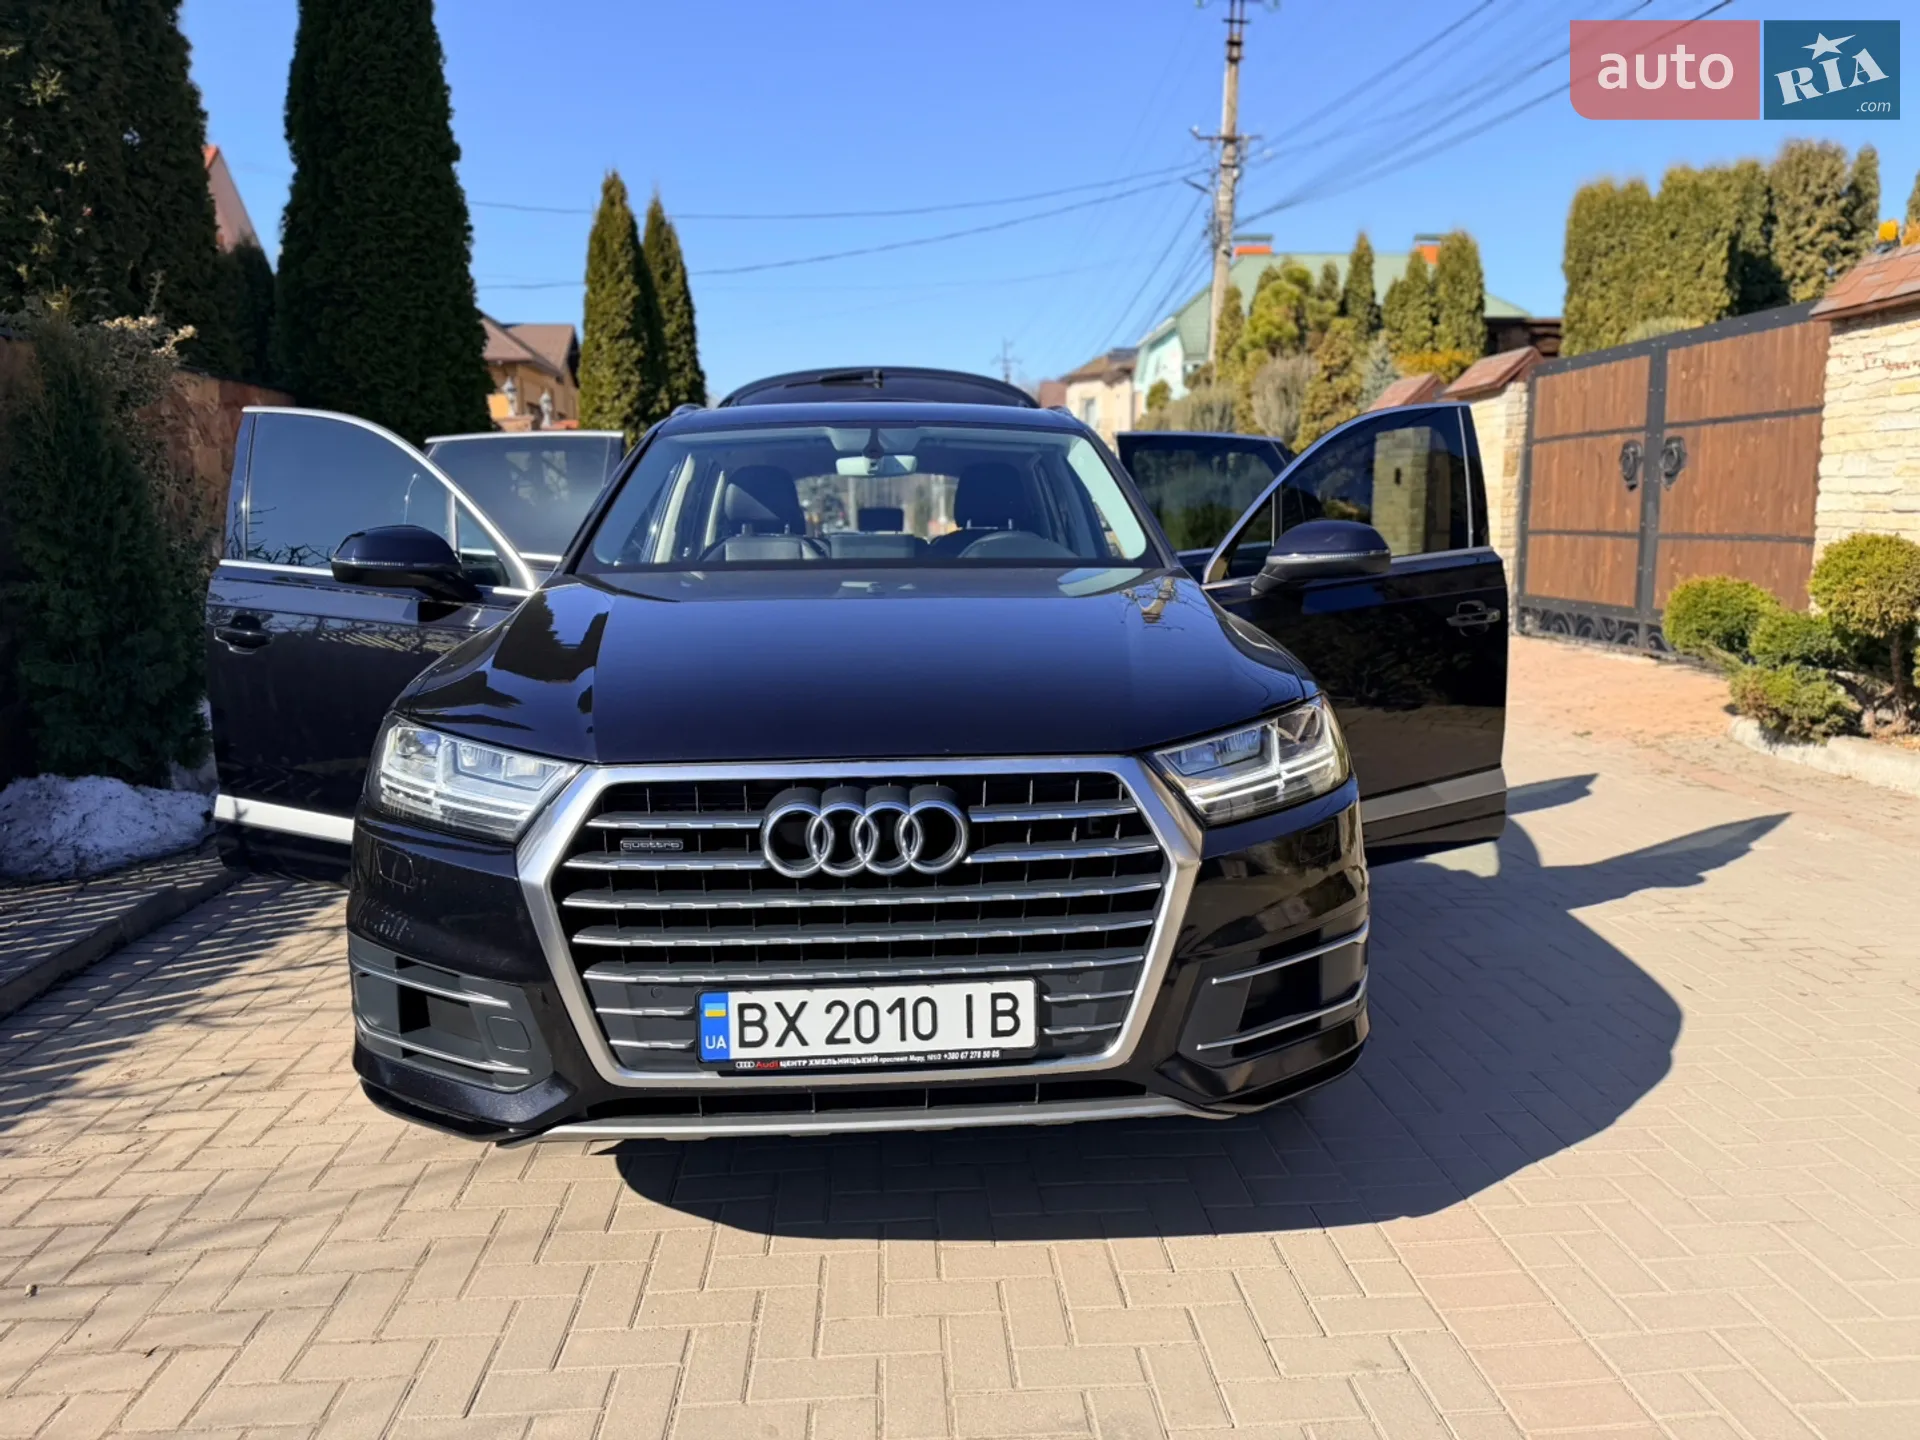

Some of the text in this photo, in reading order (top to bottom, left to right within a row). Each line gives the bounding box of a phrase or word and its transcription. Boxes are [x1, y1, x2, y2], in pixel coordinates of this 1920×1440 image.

[622, 842, 680, 850] quattro
[737, 1001, 809, 1049] BX
[824, 996, 938, 1045] 2010
[705, 1034, 727, 1050] UA
[756, 1060, 778, 1069] Audi
[779, 1058, 807, 1068] ЦЕНТР
[808, 1054, 878, 1066] ХМЕЛЬНИЦЬКИЙ
